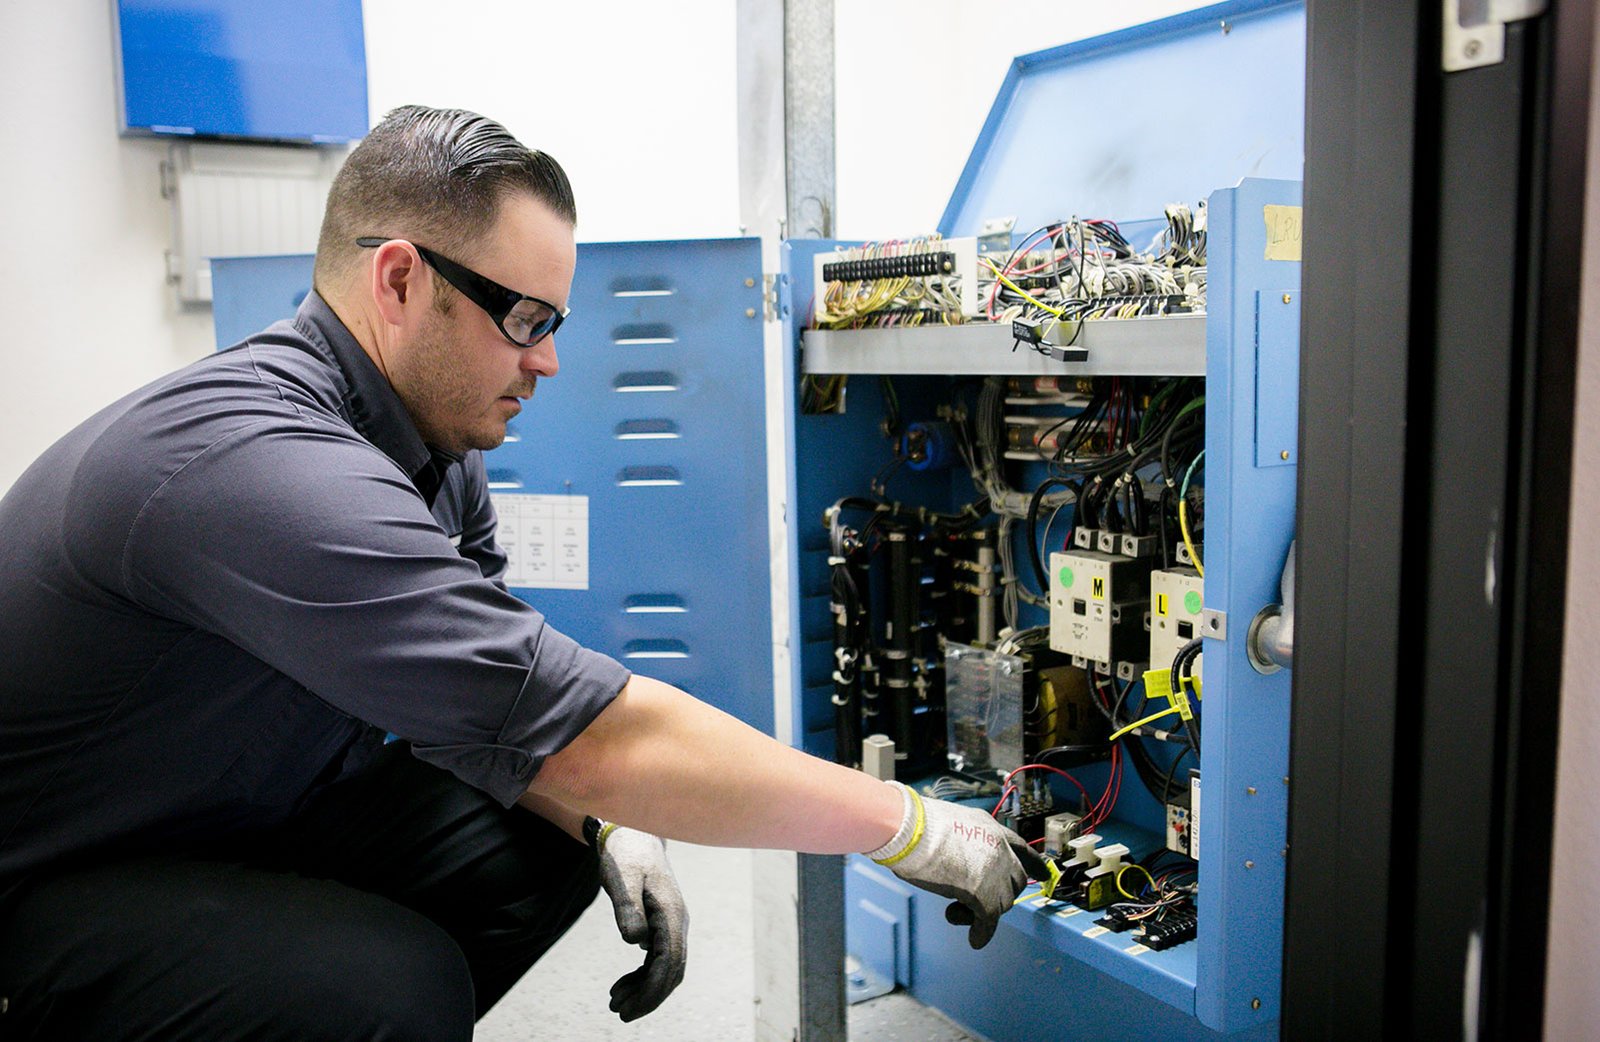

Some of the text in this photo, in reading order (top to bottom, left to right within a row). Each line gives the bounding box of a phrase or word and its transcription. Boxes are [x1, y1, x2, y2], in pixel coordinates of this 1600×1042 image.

[1093, 578, 1103, 597] M
[1158, 594, 1166, 615] L
[953, 821, 1002, 849] HyFlex
